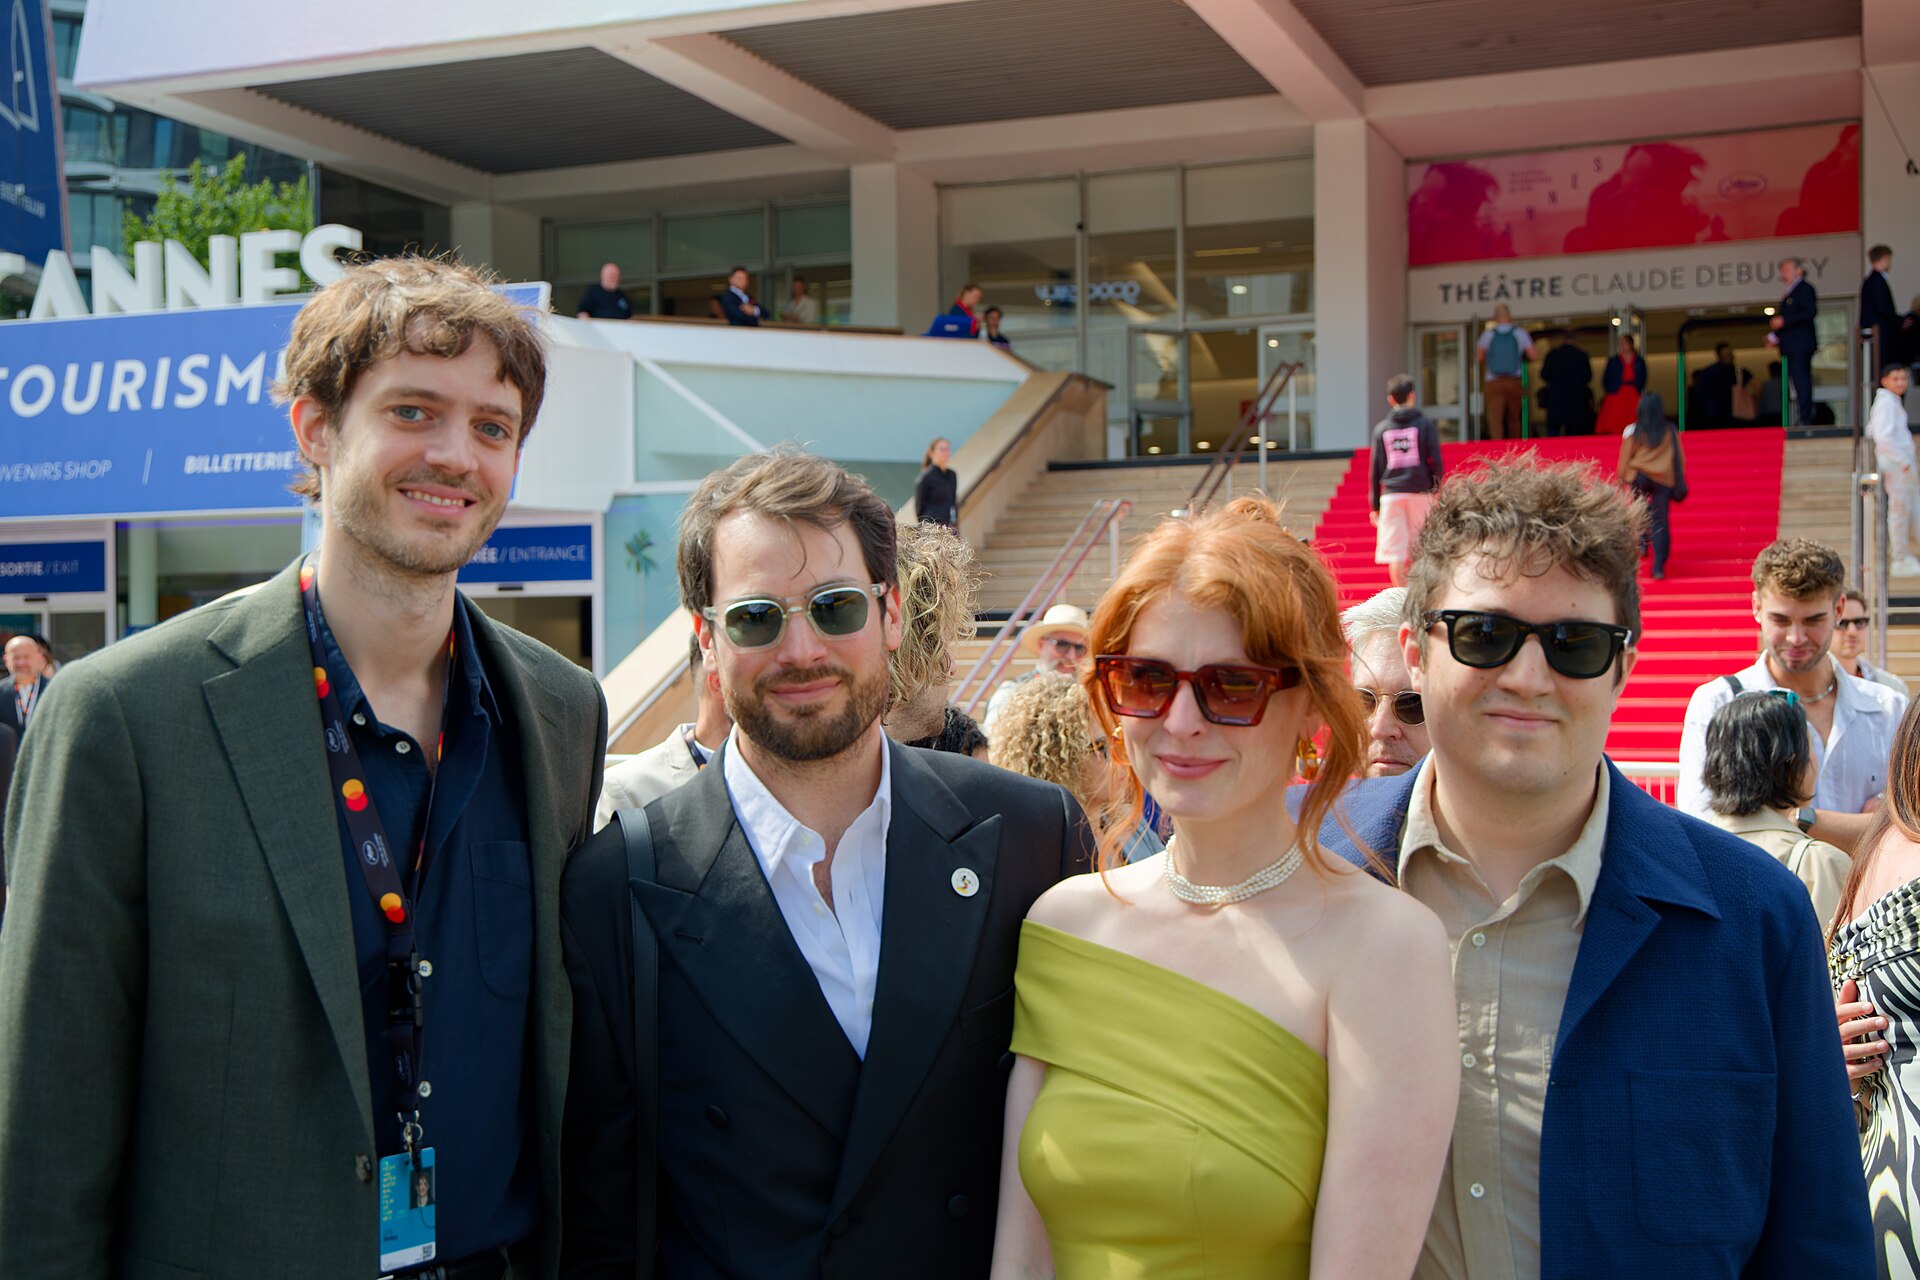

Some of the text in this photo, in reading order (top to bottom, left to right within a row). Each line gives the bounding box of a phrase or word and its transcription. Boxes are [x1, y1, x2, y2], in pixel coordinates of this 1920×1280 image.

[1438, 255, 1830, 303] THÉÂTRE CLAUDE DEBUY
[64, 459, 113, 481] SHOP
[184, 450, 296, 474] BILLETTERIE
[509, 544, 586, 563] ENTRANCE
[52, 559, 79, 576] EXIT
